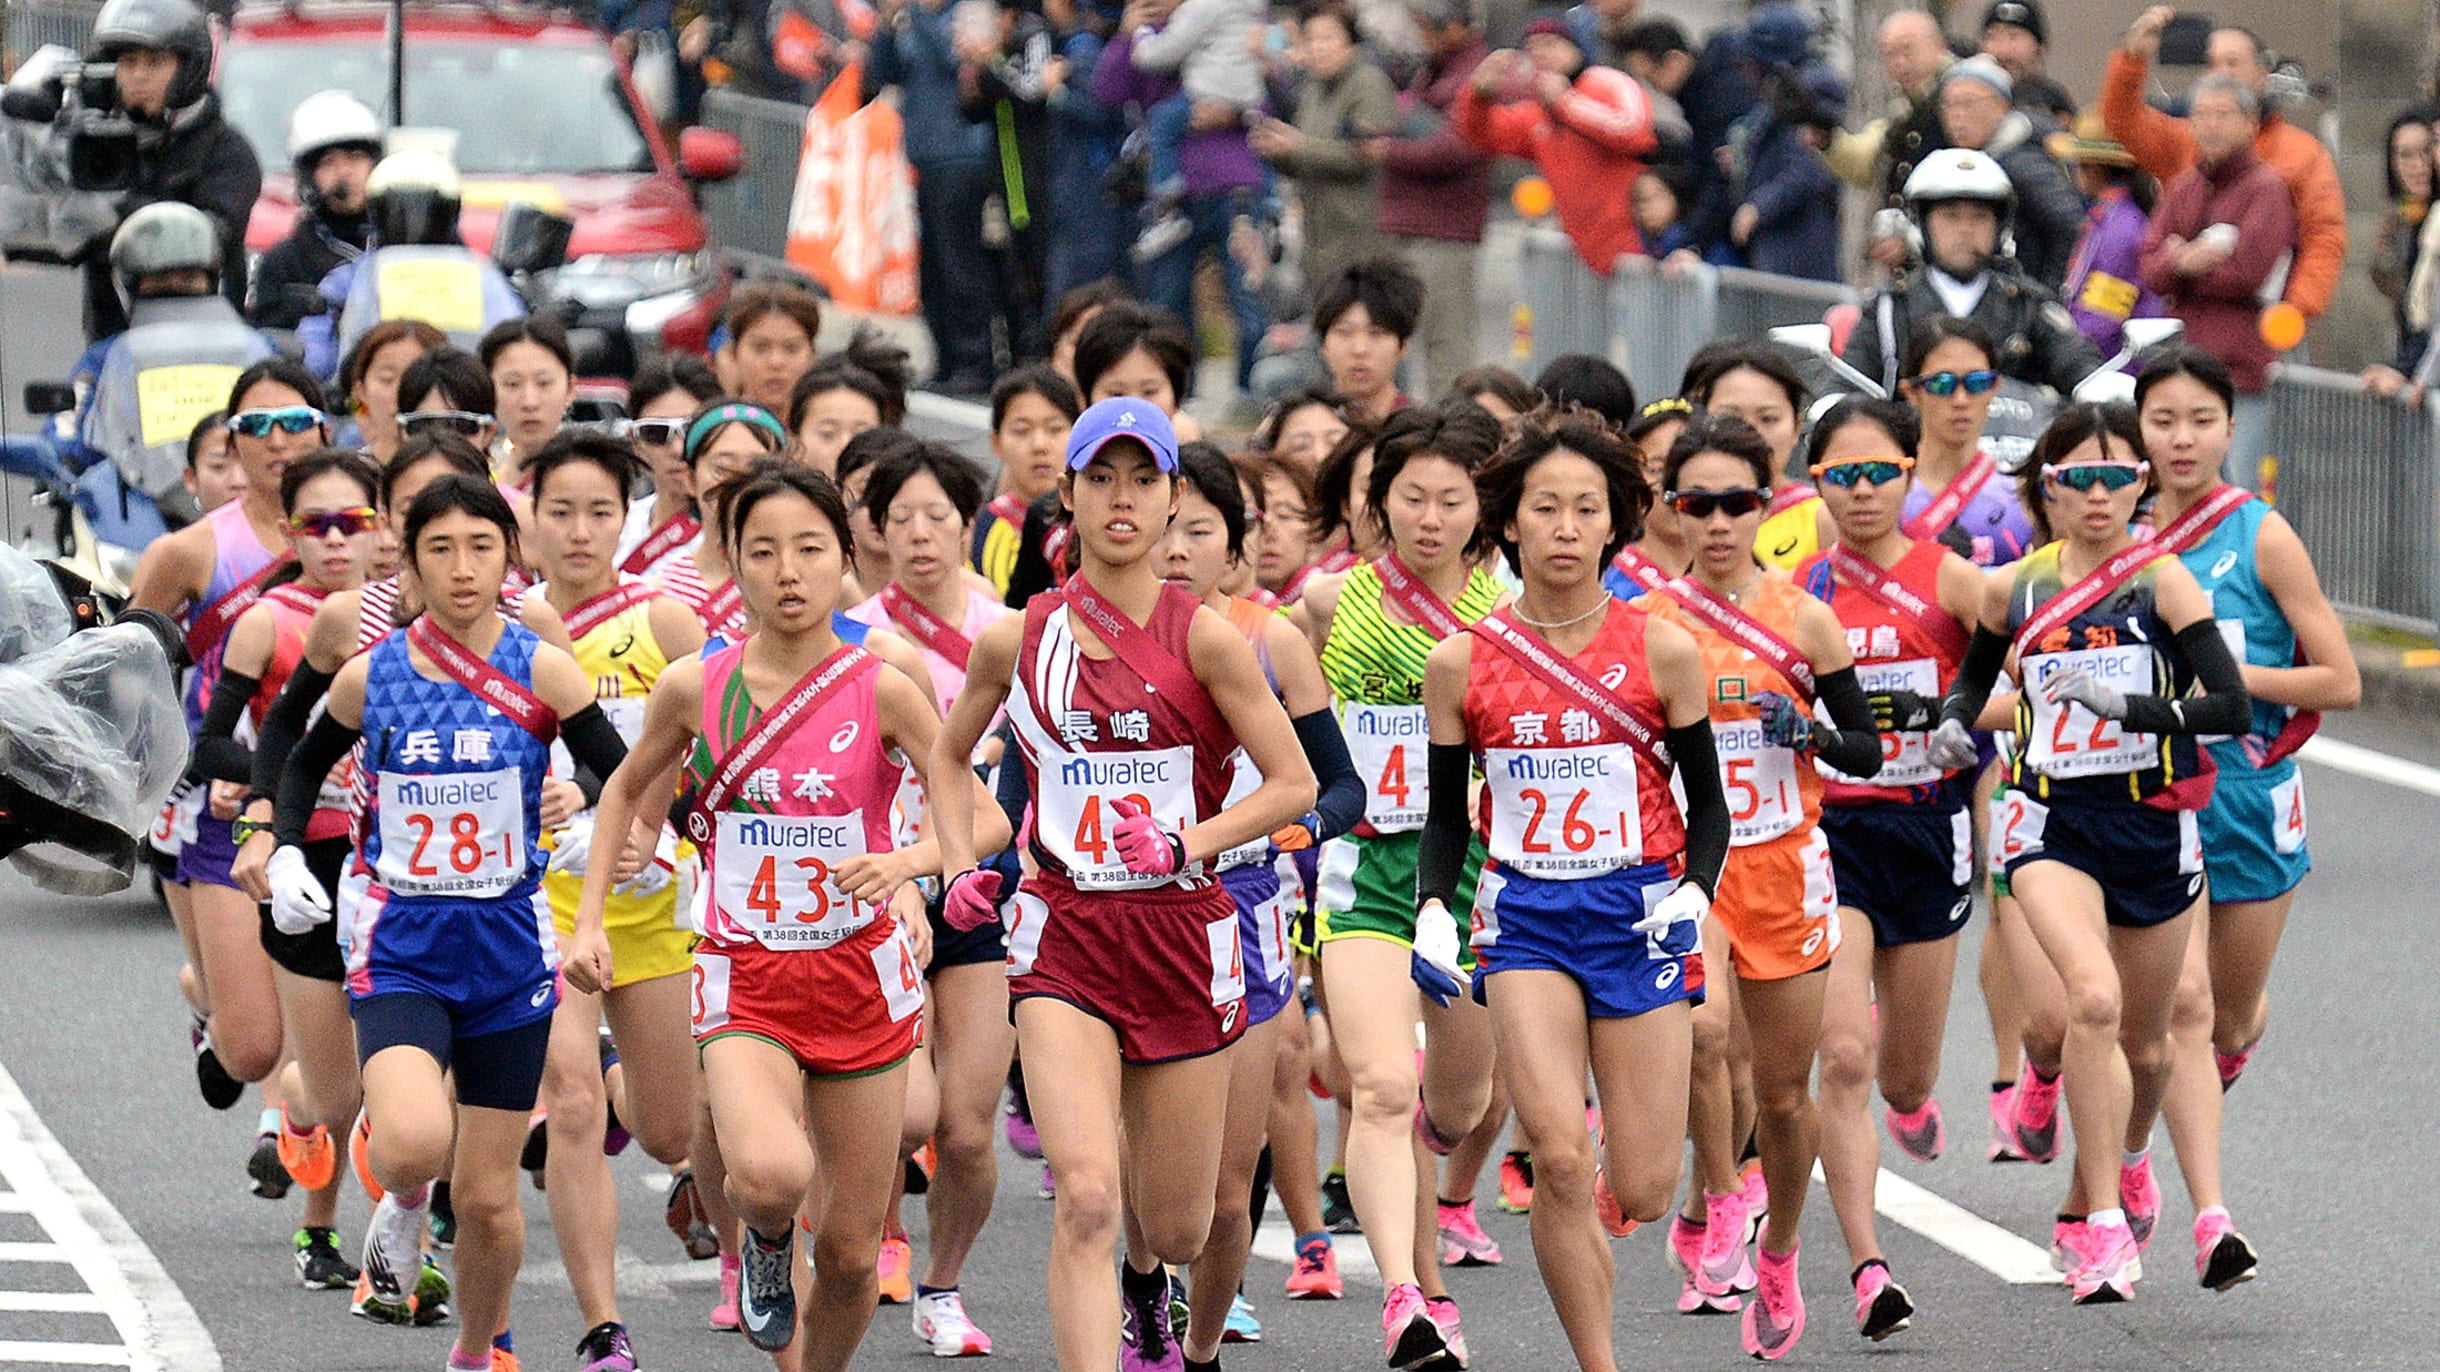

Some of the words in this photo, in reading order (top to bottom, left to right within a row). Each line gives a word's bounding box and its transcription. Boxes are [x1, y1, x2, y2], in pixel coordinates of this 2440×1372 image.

[1059, 709, 1150, 744] 長崎
[1509, 708, 1601, 745] 京都
[400, 730, 491, 763] 兵庫
[742, 767, 835, 804] 熊本
[1519, 788, 1628, 854] 26-1
[405, 812, 514, 877] 28-1
